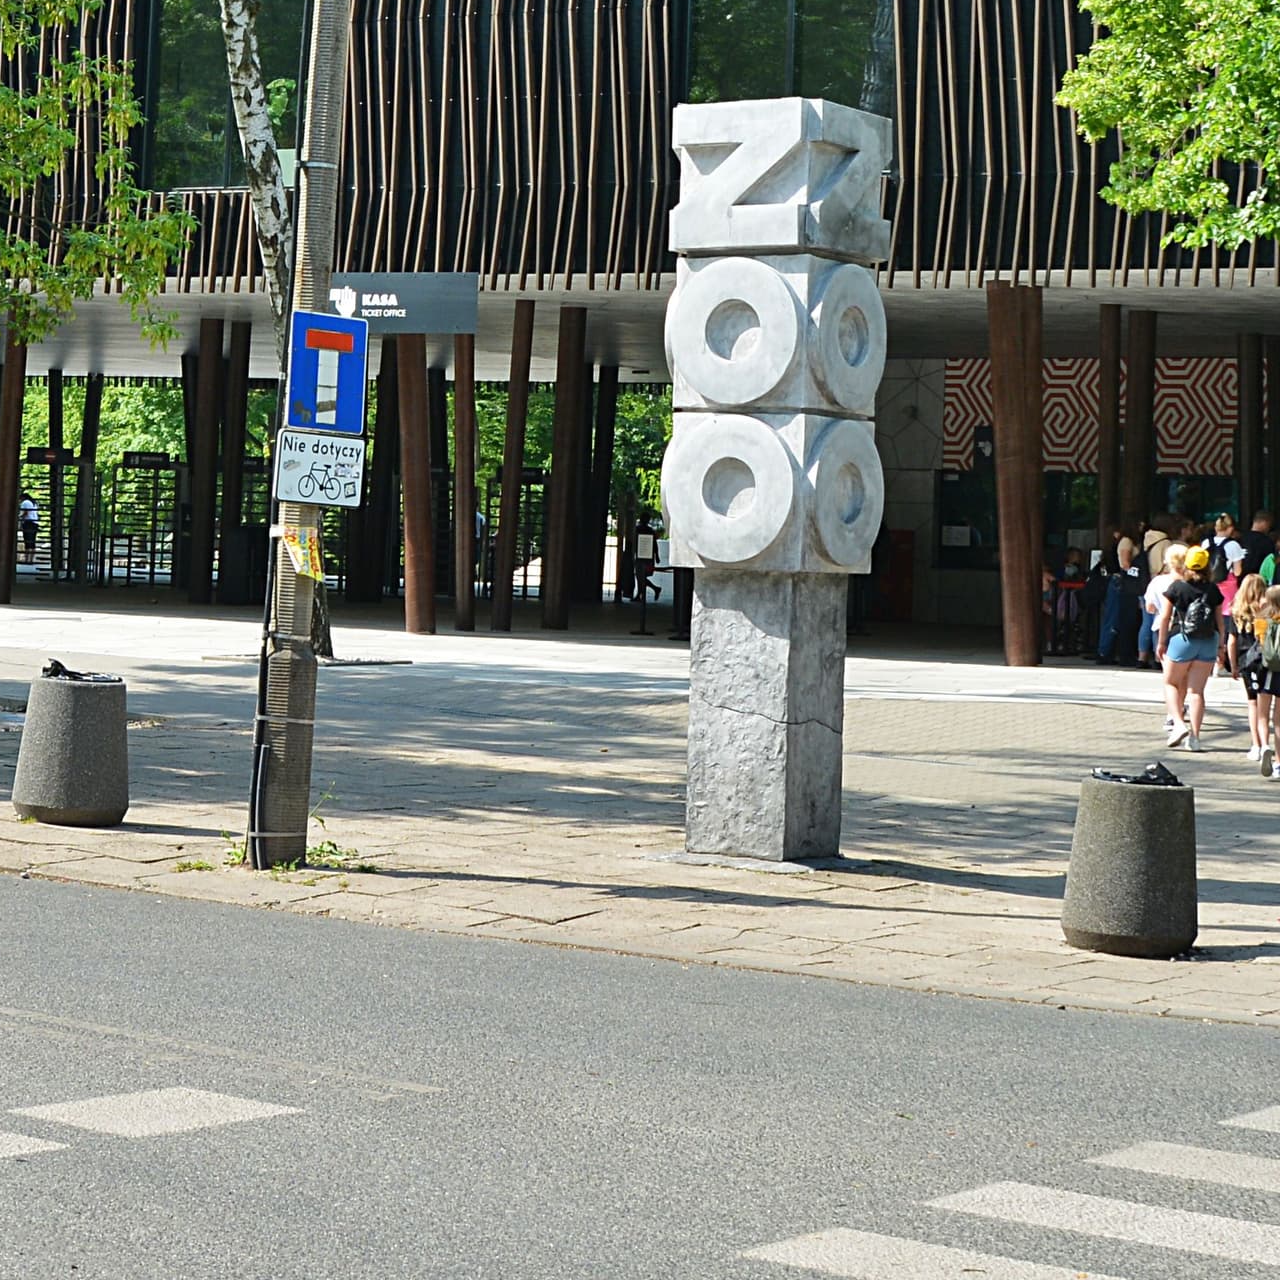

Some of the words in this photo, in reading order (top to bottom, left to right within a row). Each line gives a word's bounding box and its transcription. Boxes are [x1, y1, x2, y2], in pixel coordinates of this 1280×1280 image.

[361, 293, 399, 306] KASA
[361, 308, 382, 317] TICKET
[383, 308, 407, 318] OFFICE
[283, 435, 306, 453] Nie
[311, 439, 363, 463] dotyczy
